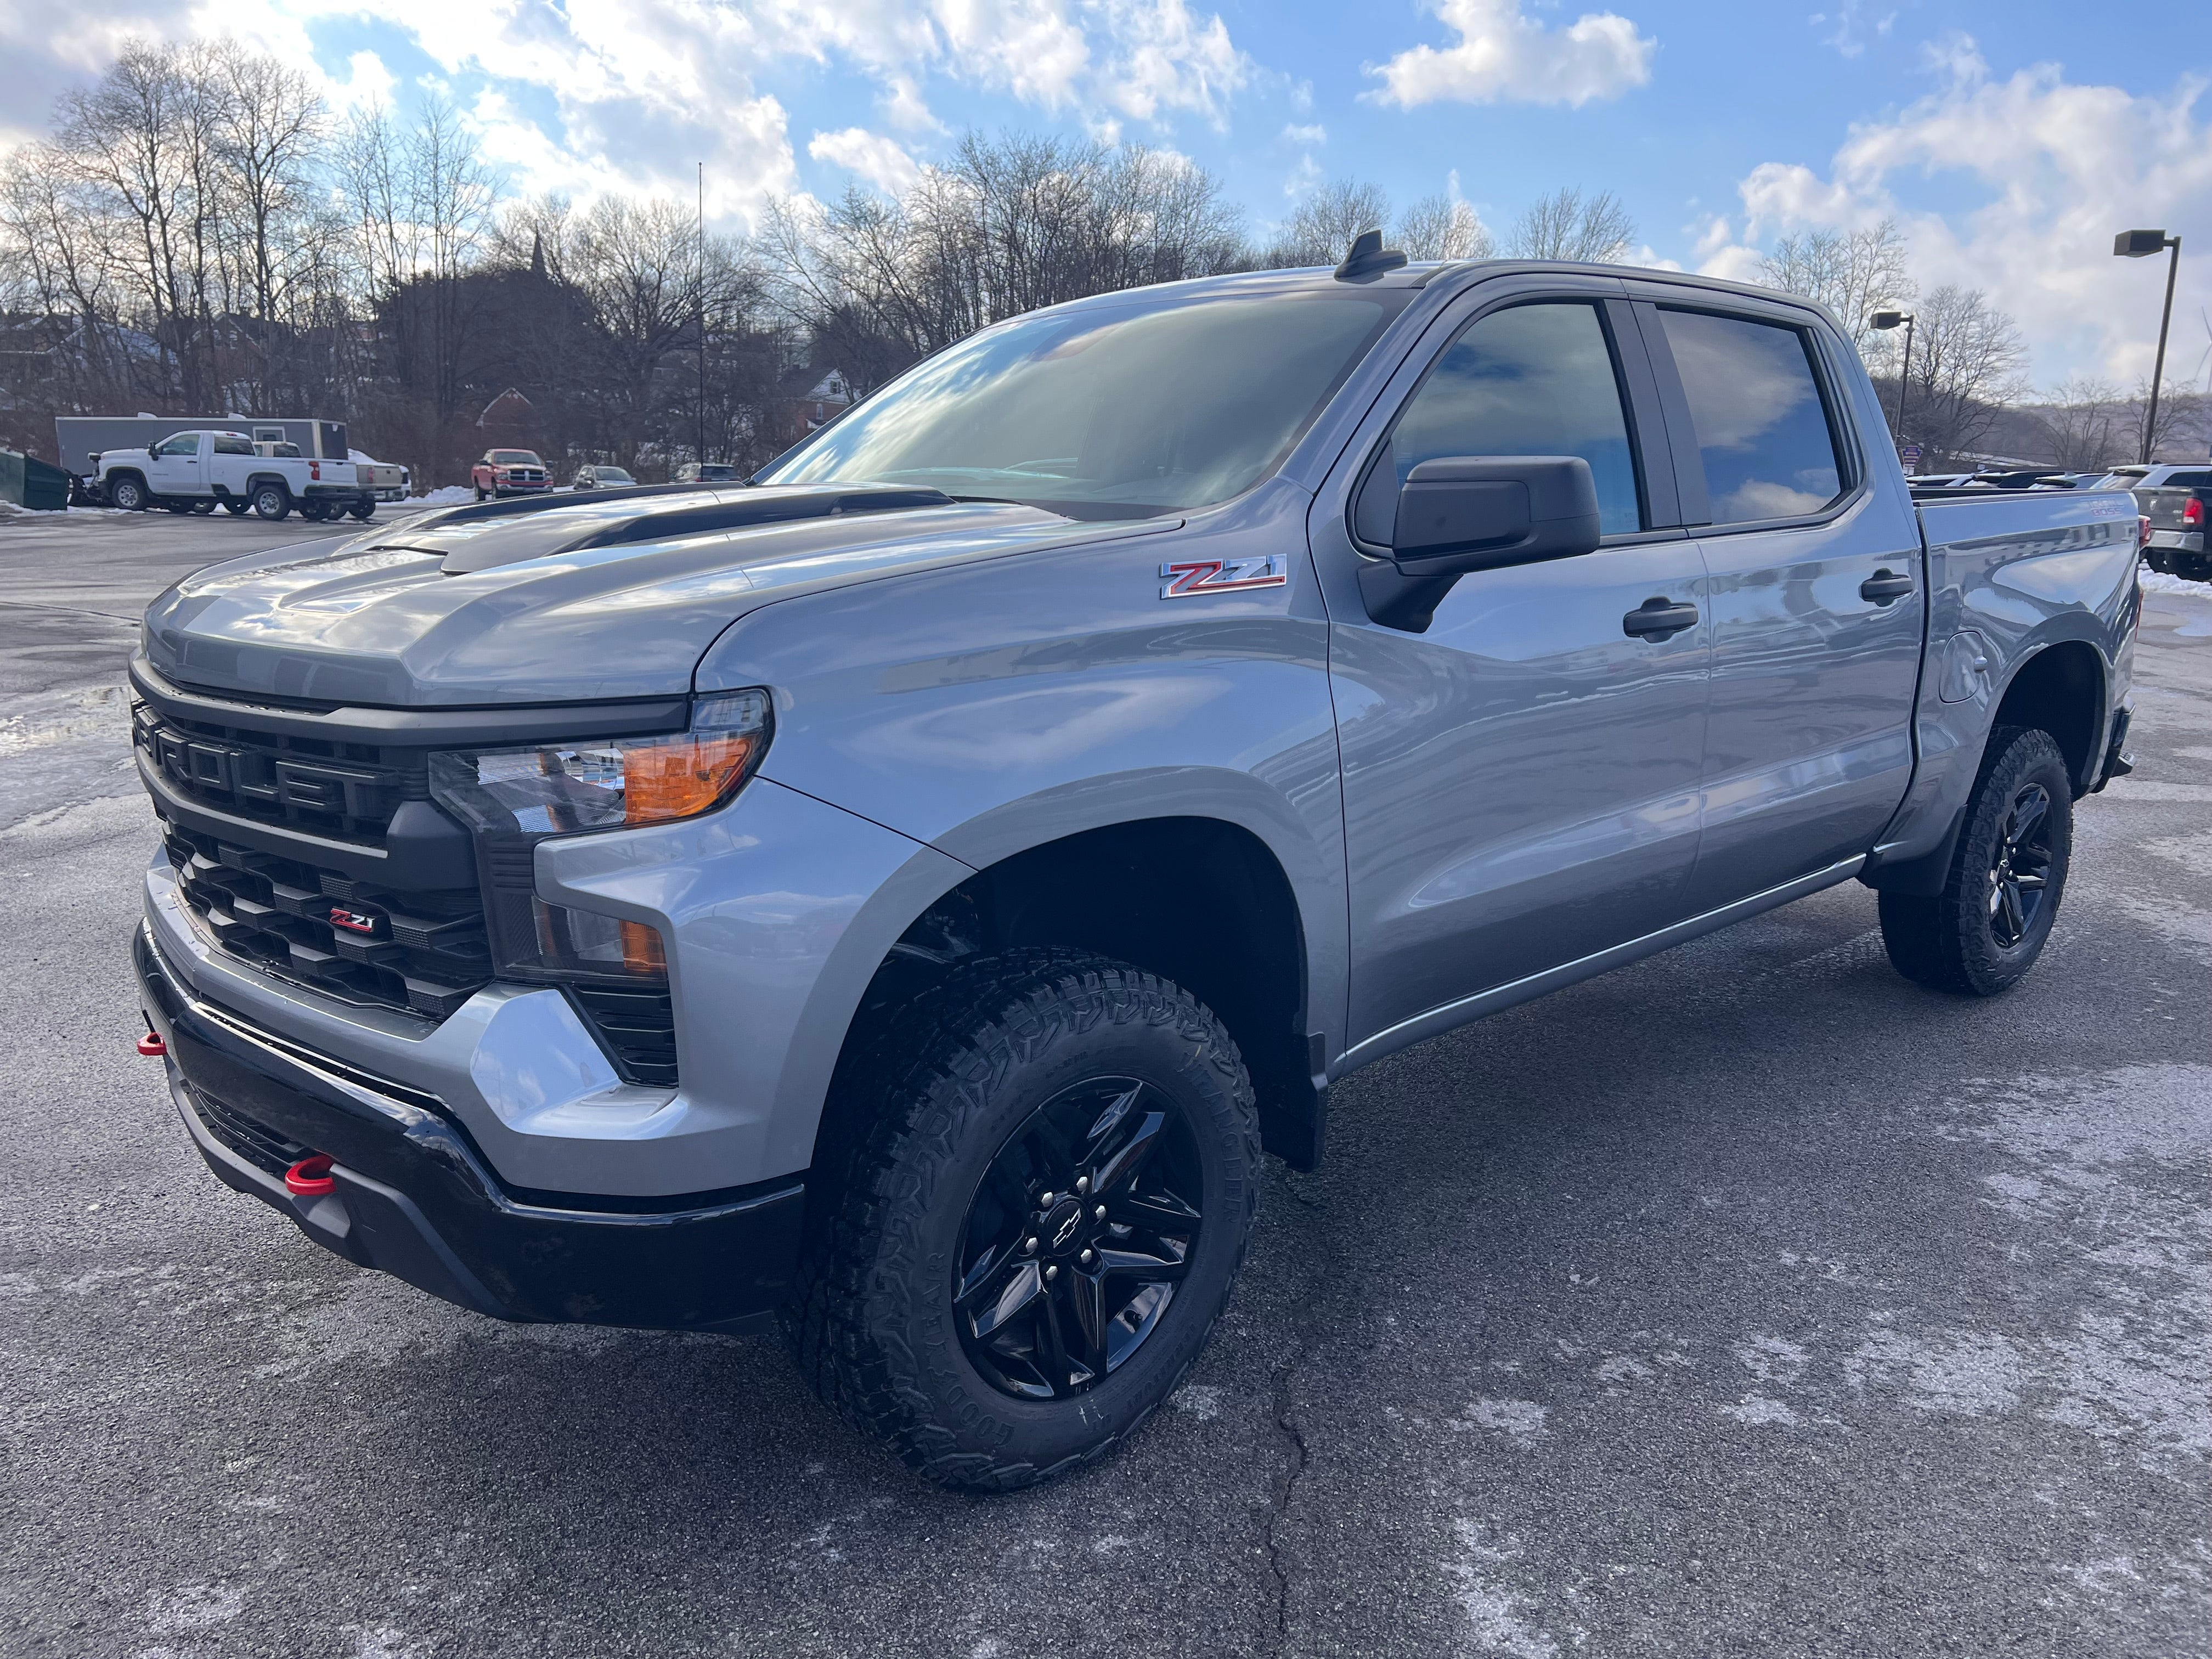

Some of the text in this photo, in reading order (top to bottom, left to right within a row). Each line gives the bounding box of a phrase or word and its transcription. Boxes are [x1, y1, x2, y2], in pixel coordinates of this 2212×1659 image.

[2080, 498, 2125, 509] TRAIL
[2091, 508, 2123, 517] BOSS
[1160, 554, 1287, 600] Z71
[330, 906, 375, 933] Z71
[922, 1252, 1015, 1446] GOODYEAR
